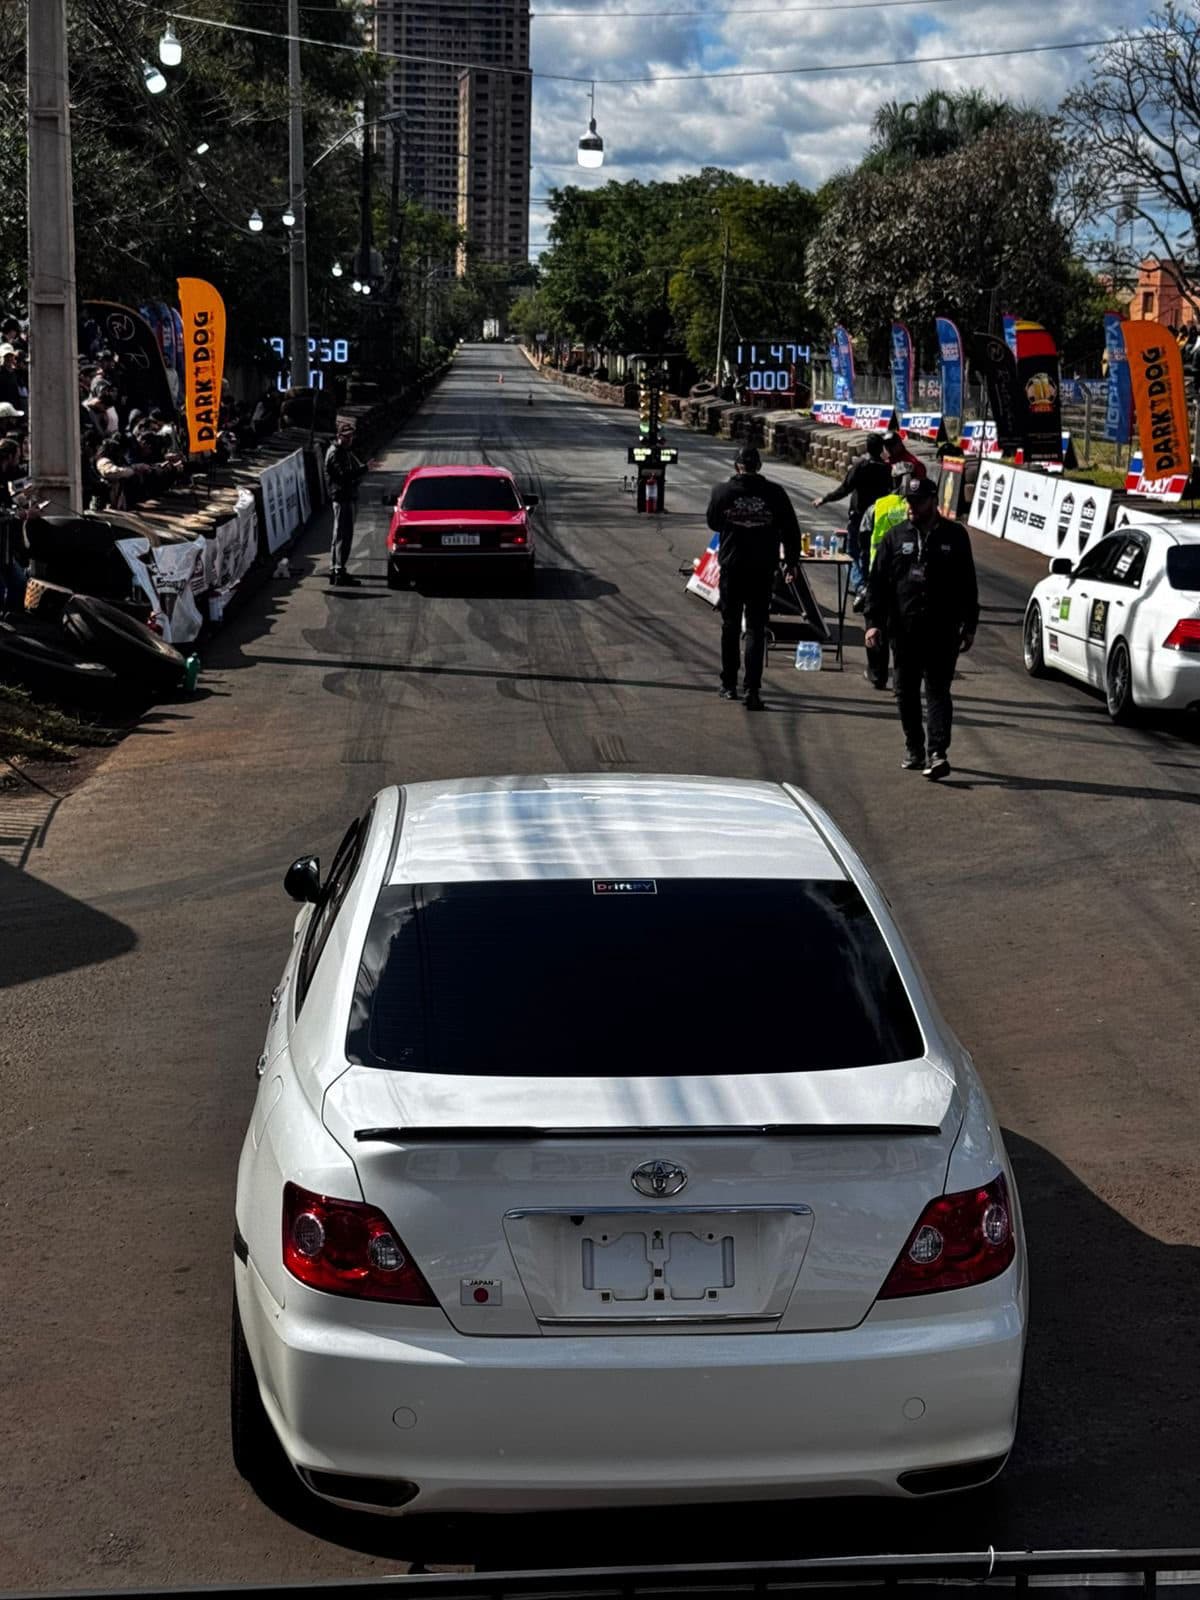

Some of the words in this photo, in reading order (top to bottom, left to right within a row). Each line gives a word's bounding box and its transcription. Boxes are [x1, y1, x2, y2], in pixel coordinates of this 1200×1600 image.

[193, 311, 210, 363] DOG
[1142, 346, 1167, 399] DOG
[194, 379, 215, 442] DARK
[1151, 410, 1176, 472] DARK
